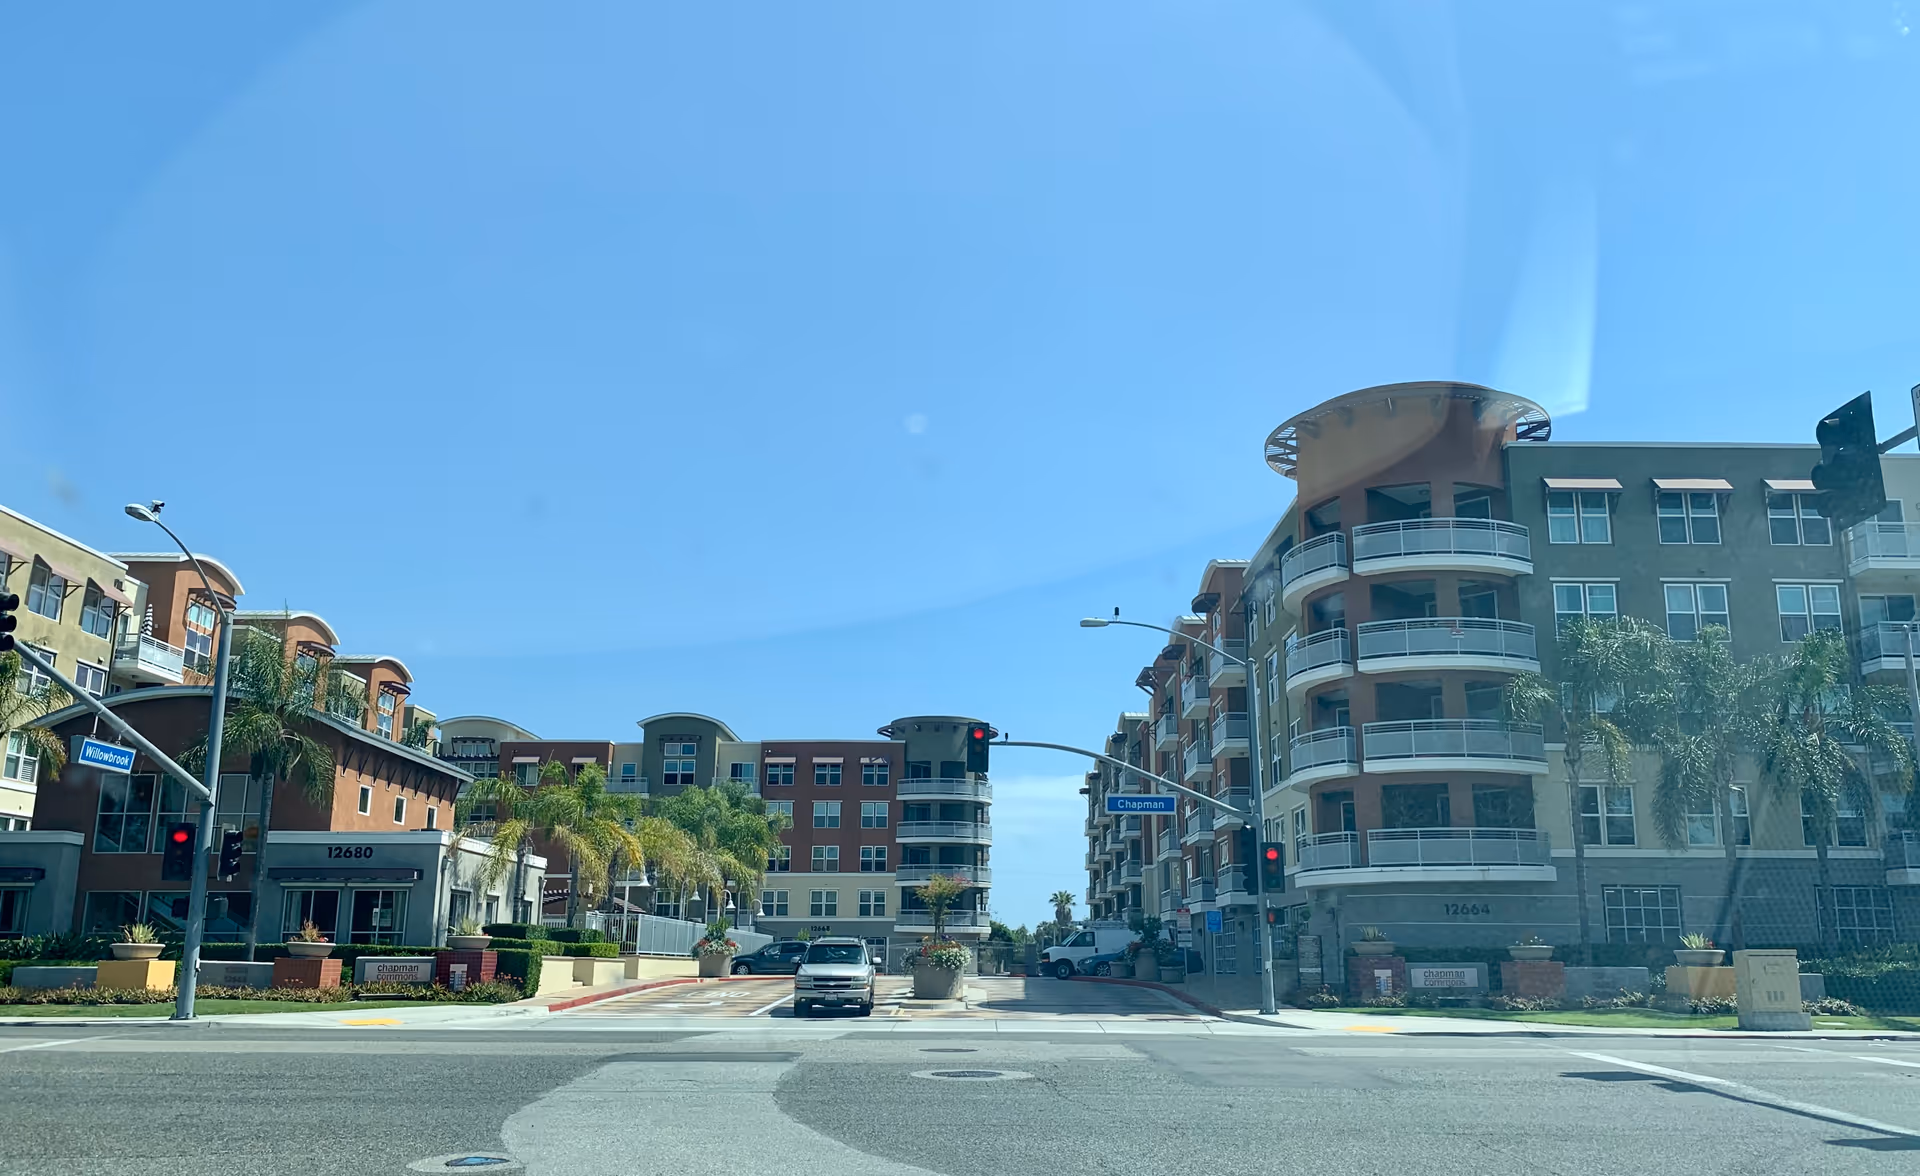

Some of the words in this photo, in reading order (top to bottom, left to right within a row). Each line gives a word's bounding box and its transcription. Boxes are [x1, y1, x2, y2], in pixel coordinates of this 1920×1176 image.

[85, 745, 130, 766] Willowbrook
[1117, 799, 1165, 811] Chapman
[327, 846, 374, 859] 12680
[1444, 903, 1491, 916] 12664
[377, 963, 419, 973] chapman
[1423, 969, 1466, 979] chapman
